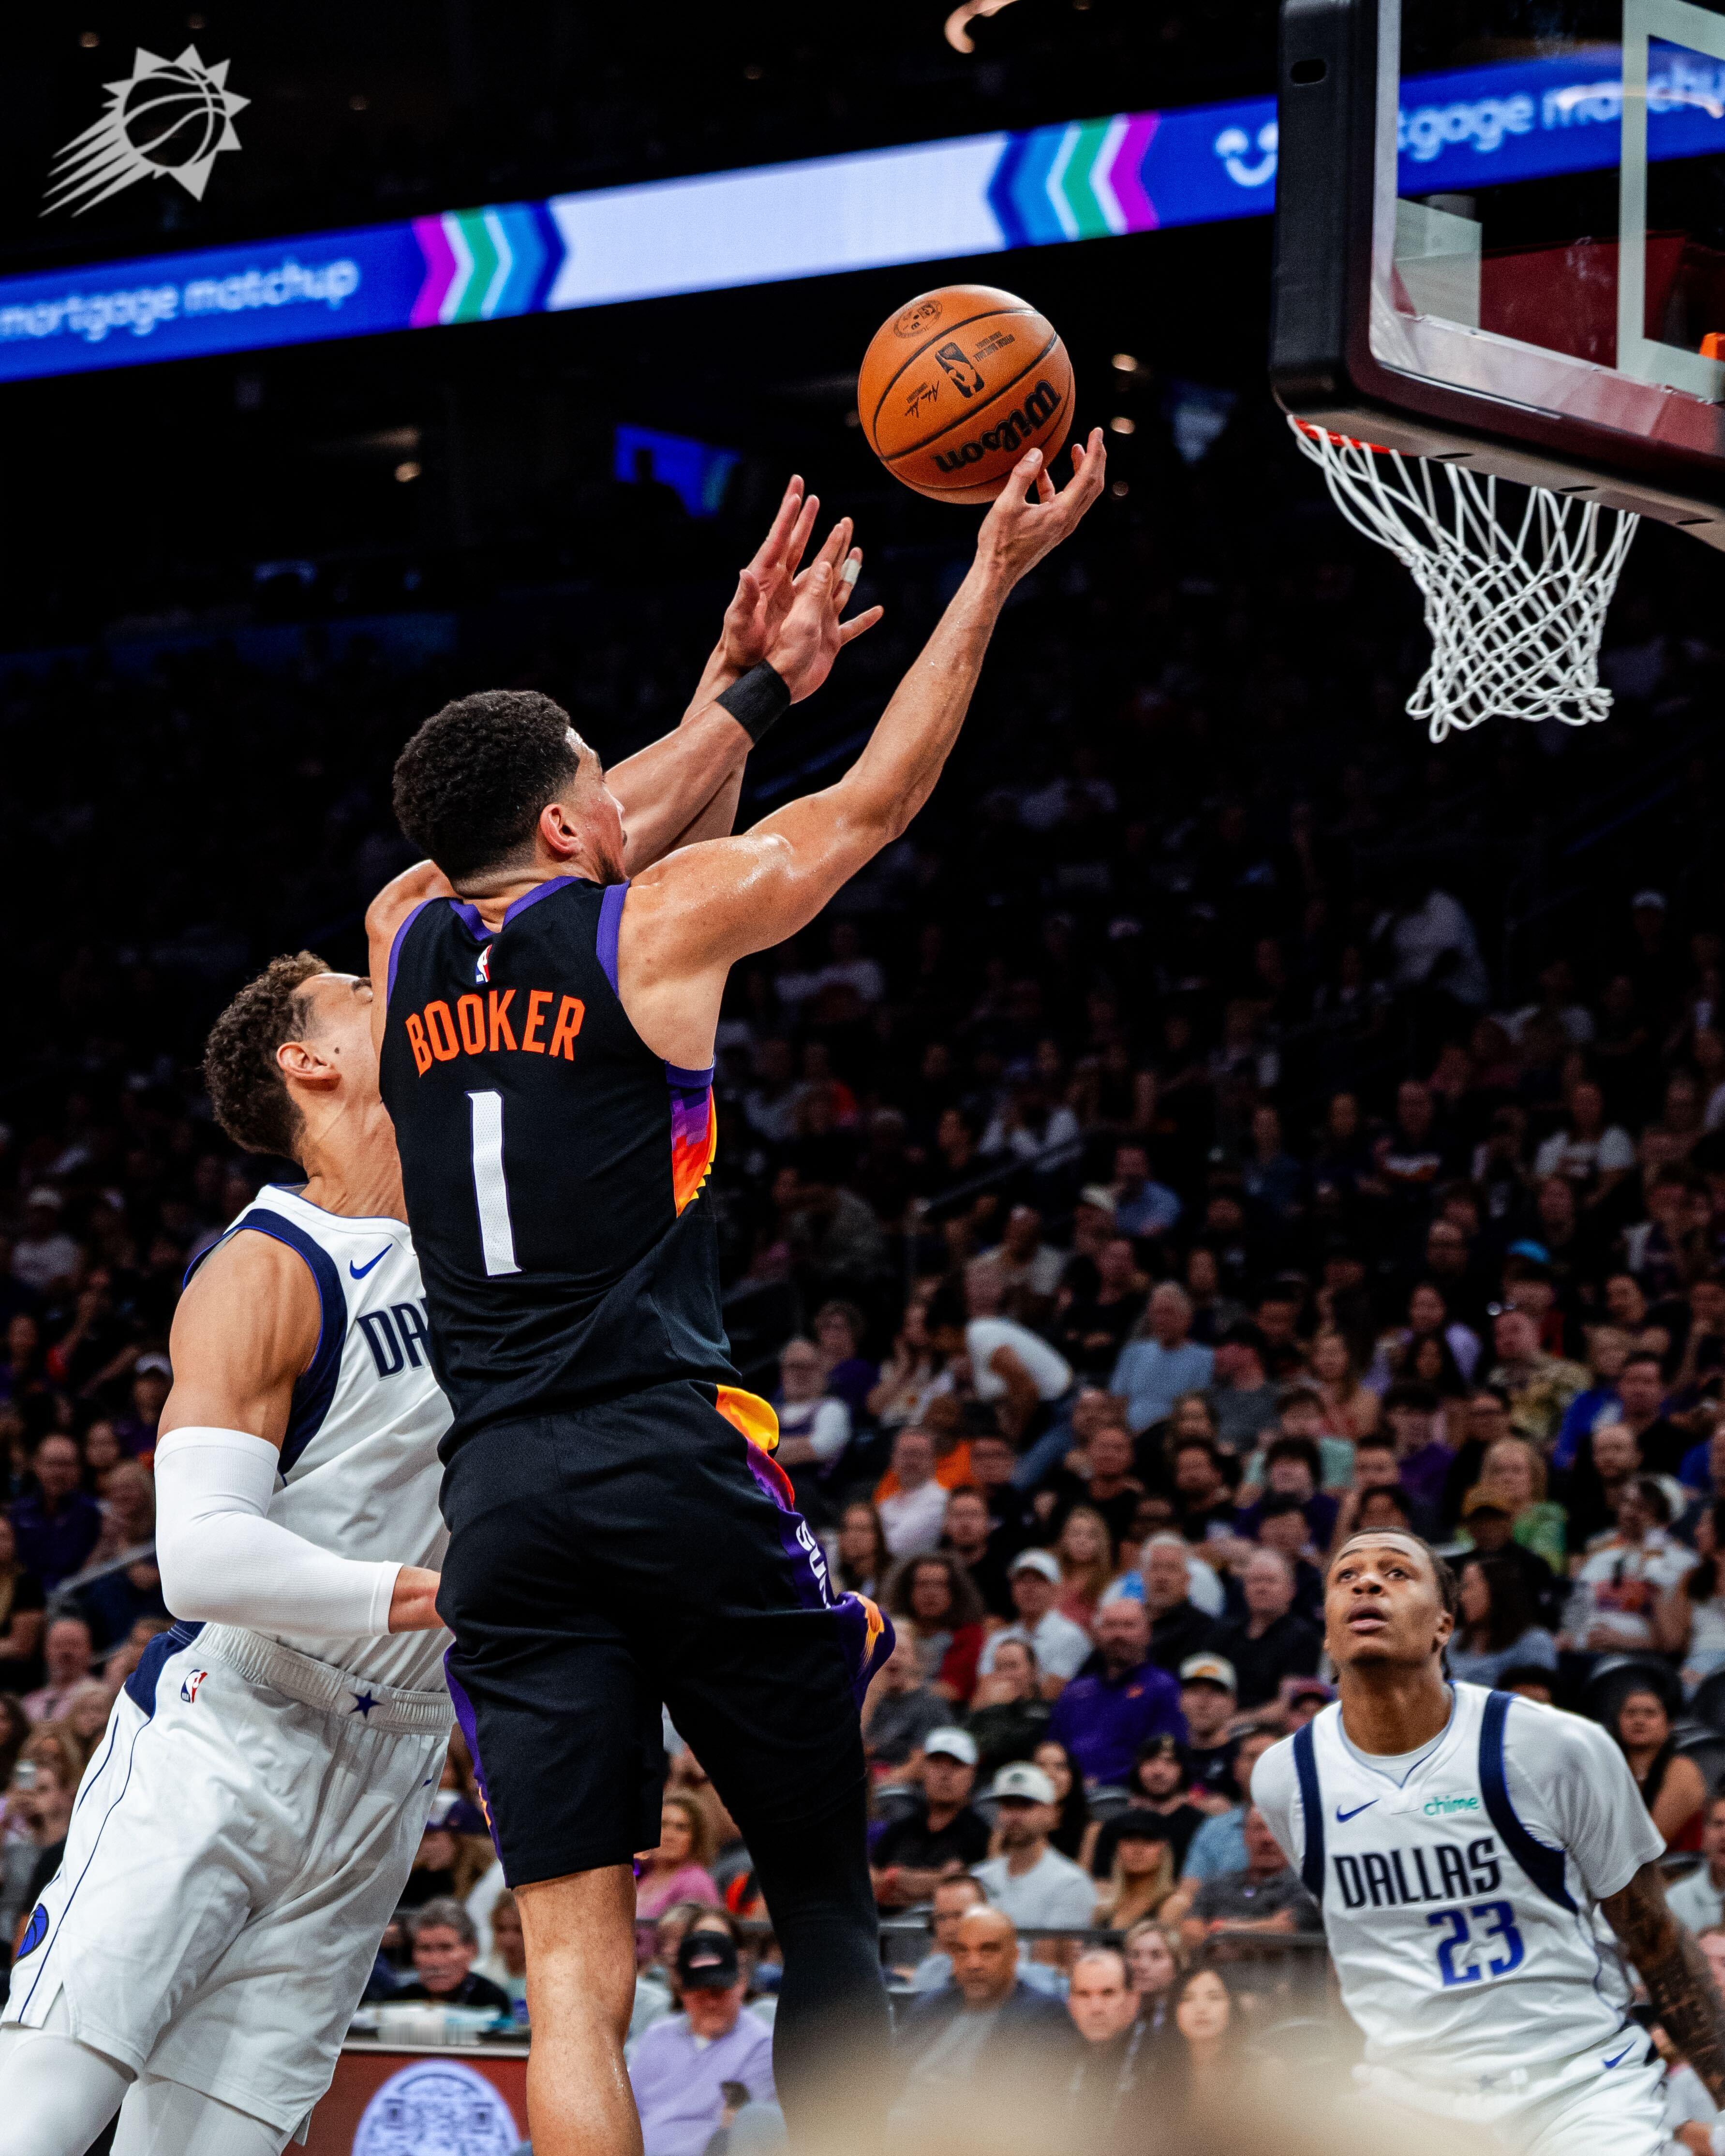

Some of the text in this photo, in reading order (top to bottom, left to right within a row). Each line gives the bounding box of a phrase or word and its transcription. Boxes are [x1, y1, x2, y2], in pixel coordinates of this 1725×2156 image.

[183, 257, 359, 317] matchup
[930, 380, 1062, 473] Wilson
[405, 989, 585, 1077] BOOKER
[464, 1088, 526, 1277] 1
[356, 1297, 431, 1379] DA
[1424, 1795, 1479, 1816] chime
[1334, 1837, 1502, 1910] DALLAS
[1426, 1900, 1524, 1987] 23
